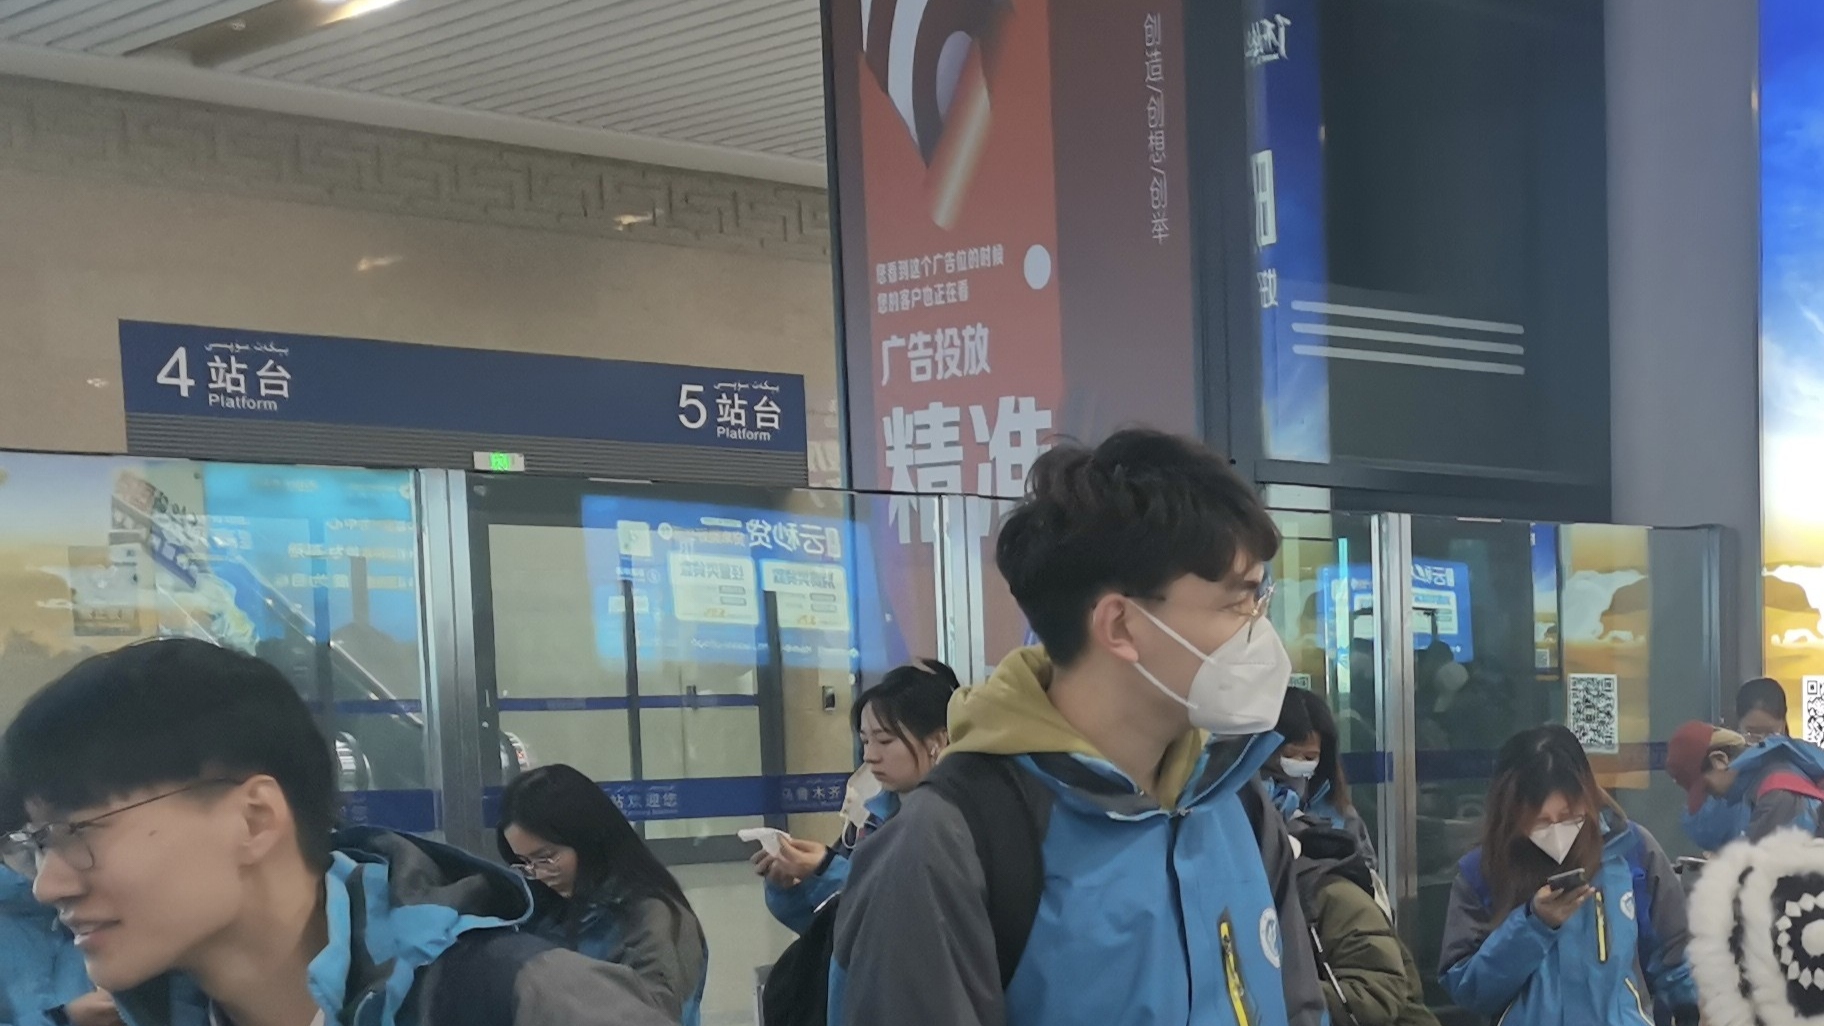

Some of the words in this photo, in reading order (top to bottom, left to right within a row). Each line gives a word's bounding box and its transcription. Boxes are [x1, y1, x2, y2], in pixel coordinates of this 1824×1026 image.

[157, 346, 196, 398] 4
[207, 355, 292, 398] 站台
[881, 322, 991, 387] 广告投放
[208, 393, 278, 411] Platform
[678, 383, 707, 429] 5
[716, 393, 781, 430] 站台
[716, 426, 771, 441] Platform
[882, 396, 1053, 546] 精准
